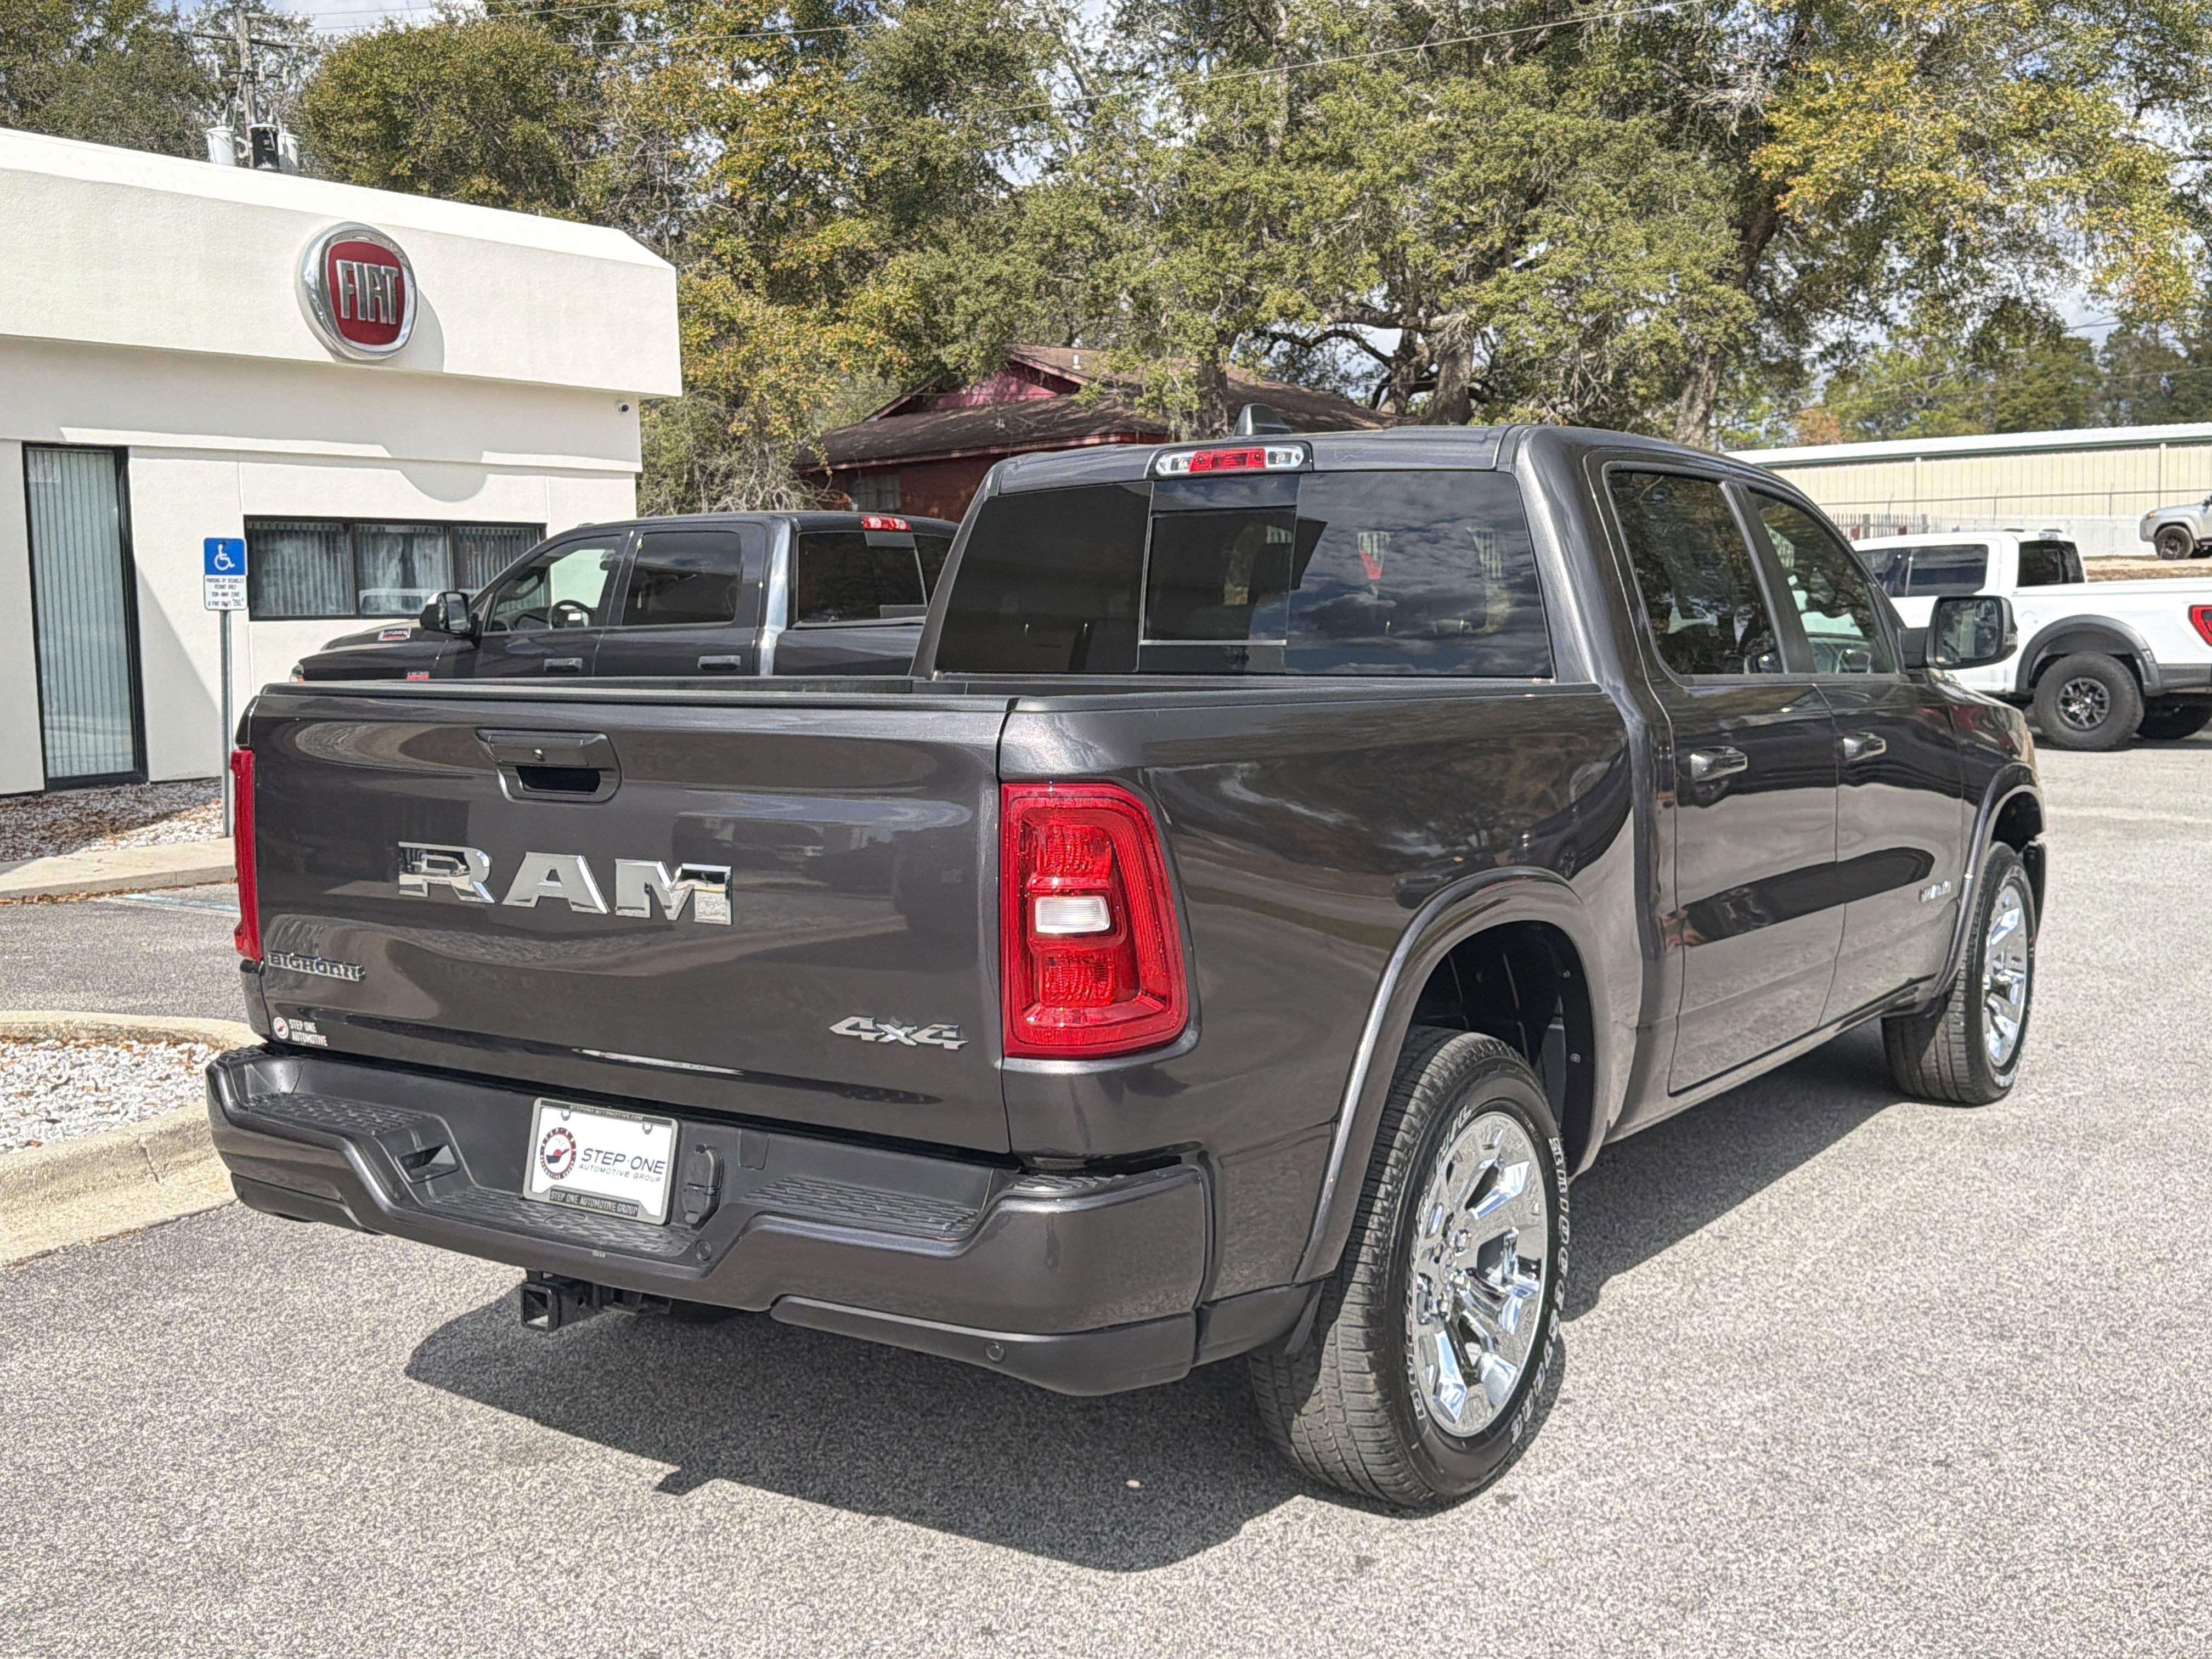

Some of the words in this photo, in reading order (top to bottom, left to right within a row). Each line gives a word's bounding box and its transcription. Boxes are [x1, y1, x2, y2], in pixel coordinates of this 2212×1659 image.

[336, 259, 399, 324] FIAT
[398, 840, 732, 926] RAM
[288, 1018, 303, 1030] STEP
[291, 1030, 328, 1047] AUTOMOTIVE
[578, 1164, 630, 1178] AUTOMOTIVE
[633, 1172, 661, 1183] GROUP
[581, 1147, 627, 1166] STEP
[630, 1155, 666, 1175] ONE
[550, 1190, 565, 1201] STEP
[566, 1194, 579, 1204] ONE
[579, 1195, 616, 1212] AUTOMOTIVE
[617, 1204, 639, 1215] GROUP
